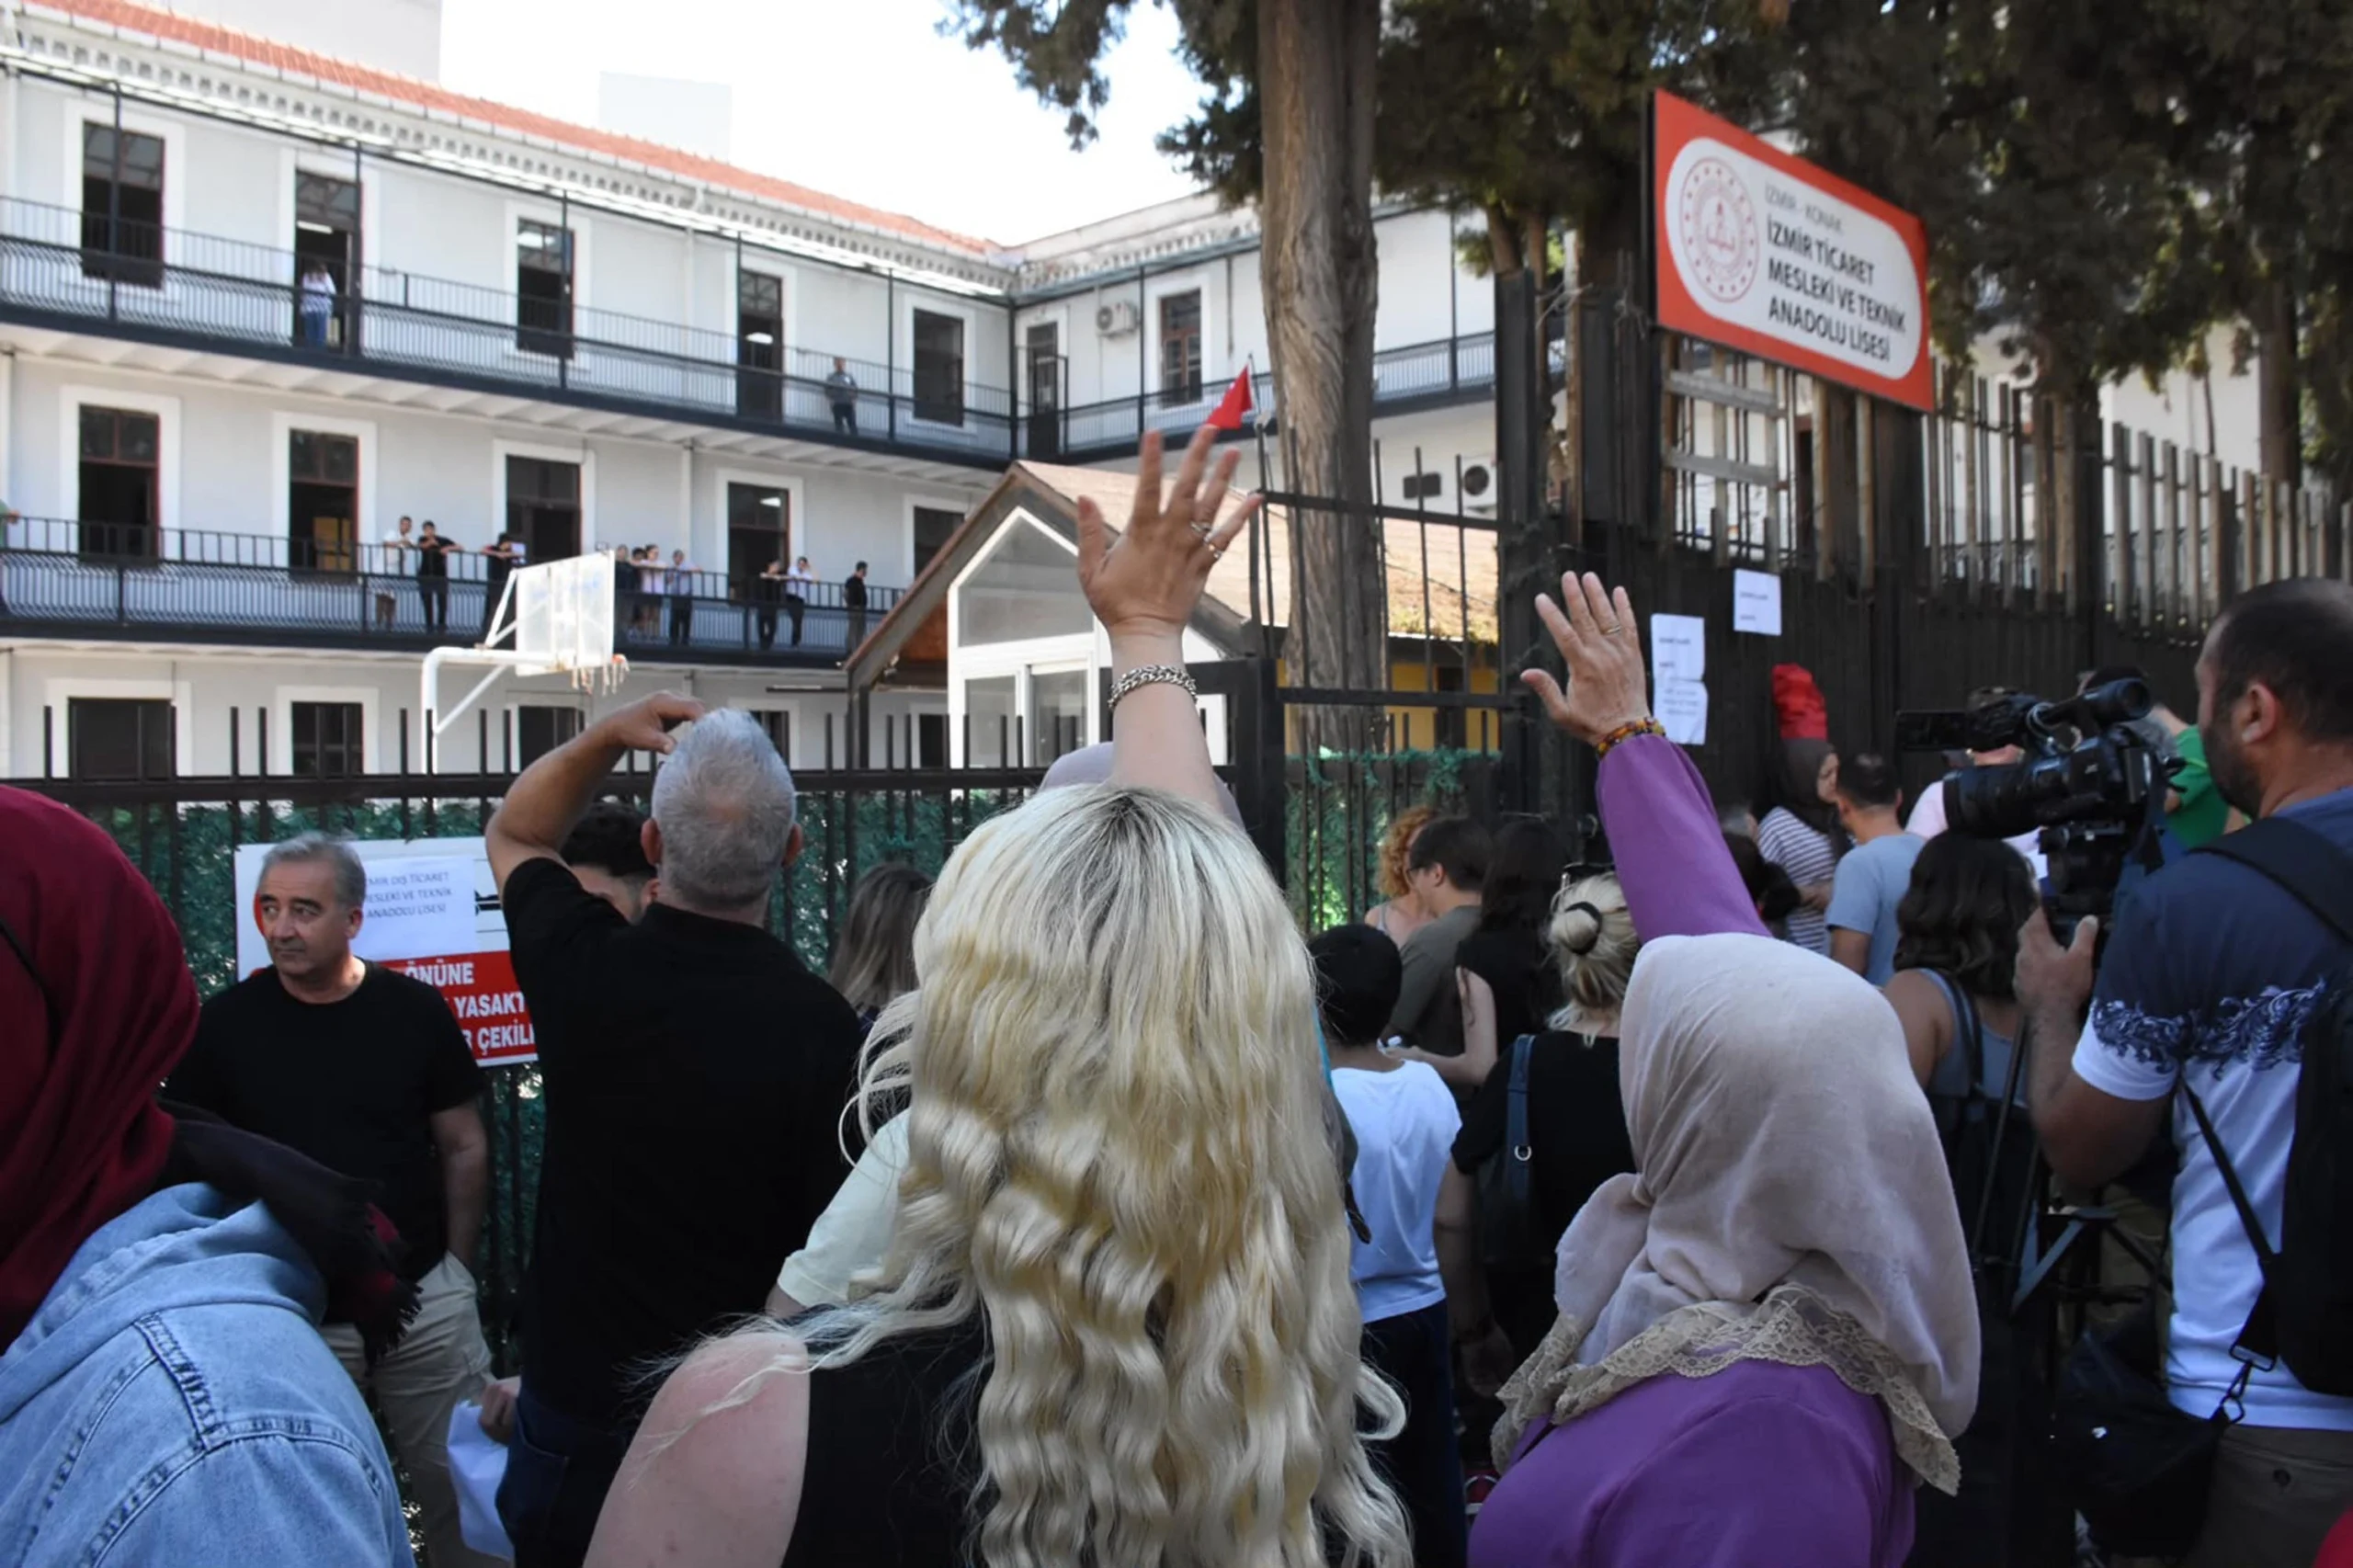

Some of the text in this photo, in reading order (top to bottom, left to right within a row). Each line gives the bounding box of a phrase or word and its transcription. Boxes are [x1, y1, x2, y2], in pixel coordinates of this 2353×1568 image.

[1767, 212, 1874, 286] İZMİR TİCARET
[1768, 257, 1906, 334] MESLEKİ VE TEKNİK
[1768, 296, 1891, 363] ANADOLU LİSESİ
